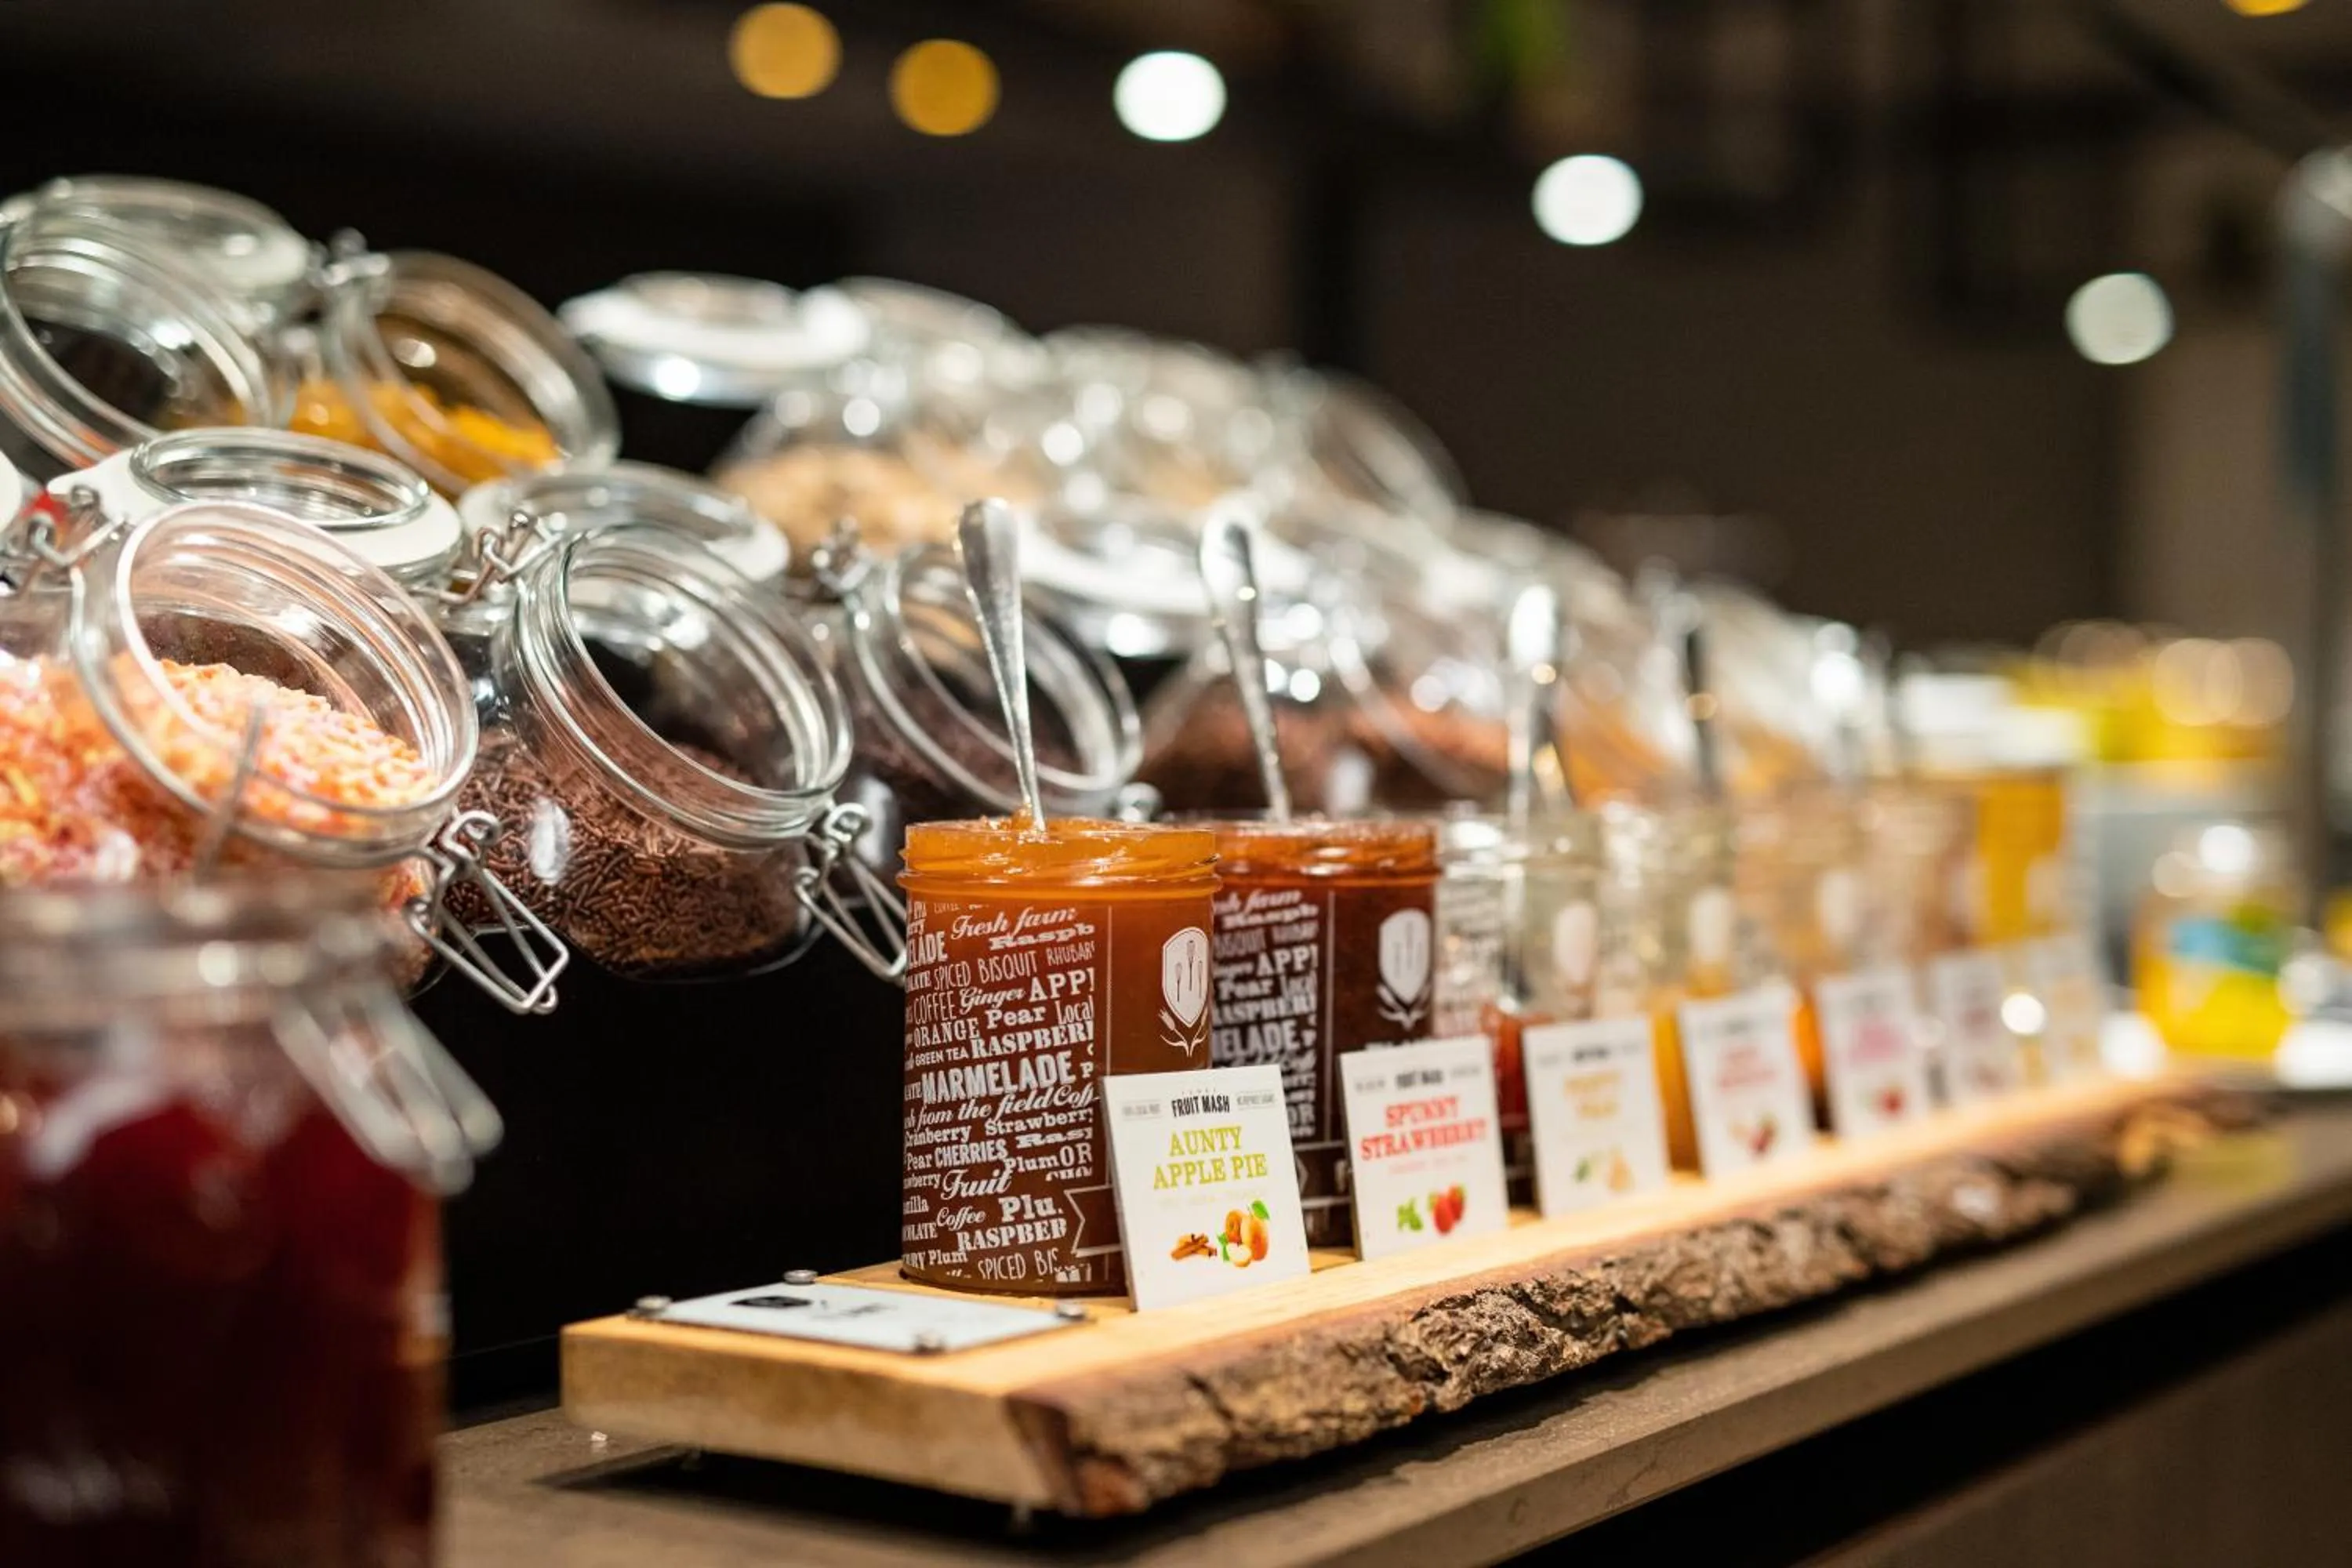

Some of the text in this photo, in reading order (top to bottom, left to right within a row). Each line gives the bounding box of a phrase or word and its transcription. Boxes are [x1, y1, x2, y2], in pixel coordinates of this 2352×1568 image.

[950, 911, 1010, 939] Fresh
[989, 923, 1095, 951] Raspb
[934, 960, 971, 991] SPICED
[978, 950, 1037, 983] BISQUIT
[913, 990, 957, 1025] COFFEE
[960, 985, 1026, 1015] Ginger
[913, 1017, 980, 1048] ORANGE
[985, 1006, 1047, 1029] Pear
[915, 1051, 944, 1067] GREEN
[946, 1046, 969, 1061] TEA
[920, 1050, 1076, 1105] MARMELADE
[916, 1101, 954, 1133] from
[957, 1098, 993, 1121] the
[993, 1087, 1054, 1123] field
[1171, 1095, 1200, 1118] FRUIT
[1202, 1094, 1230, 1114] MASH
[906, 1151, 933, 1171] Pear
[934, 1138, 1009, 1168] CHERRIES
[1169, 1126, 1241, 1156] AUNTY
[1004, 1152, 1060, 1173] Plum
[1153, 1153, 1268, 1190] APPLE PIE
[940, 1168, 1013, 1201] Fruit
[936, 1206, 986, 1232] Coffee
[929, 1248, 969, 1265] Plum
[978, 1252, 1027, 1280] SPICED
